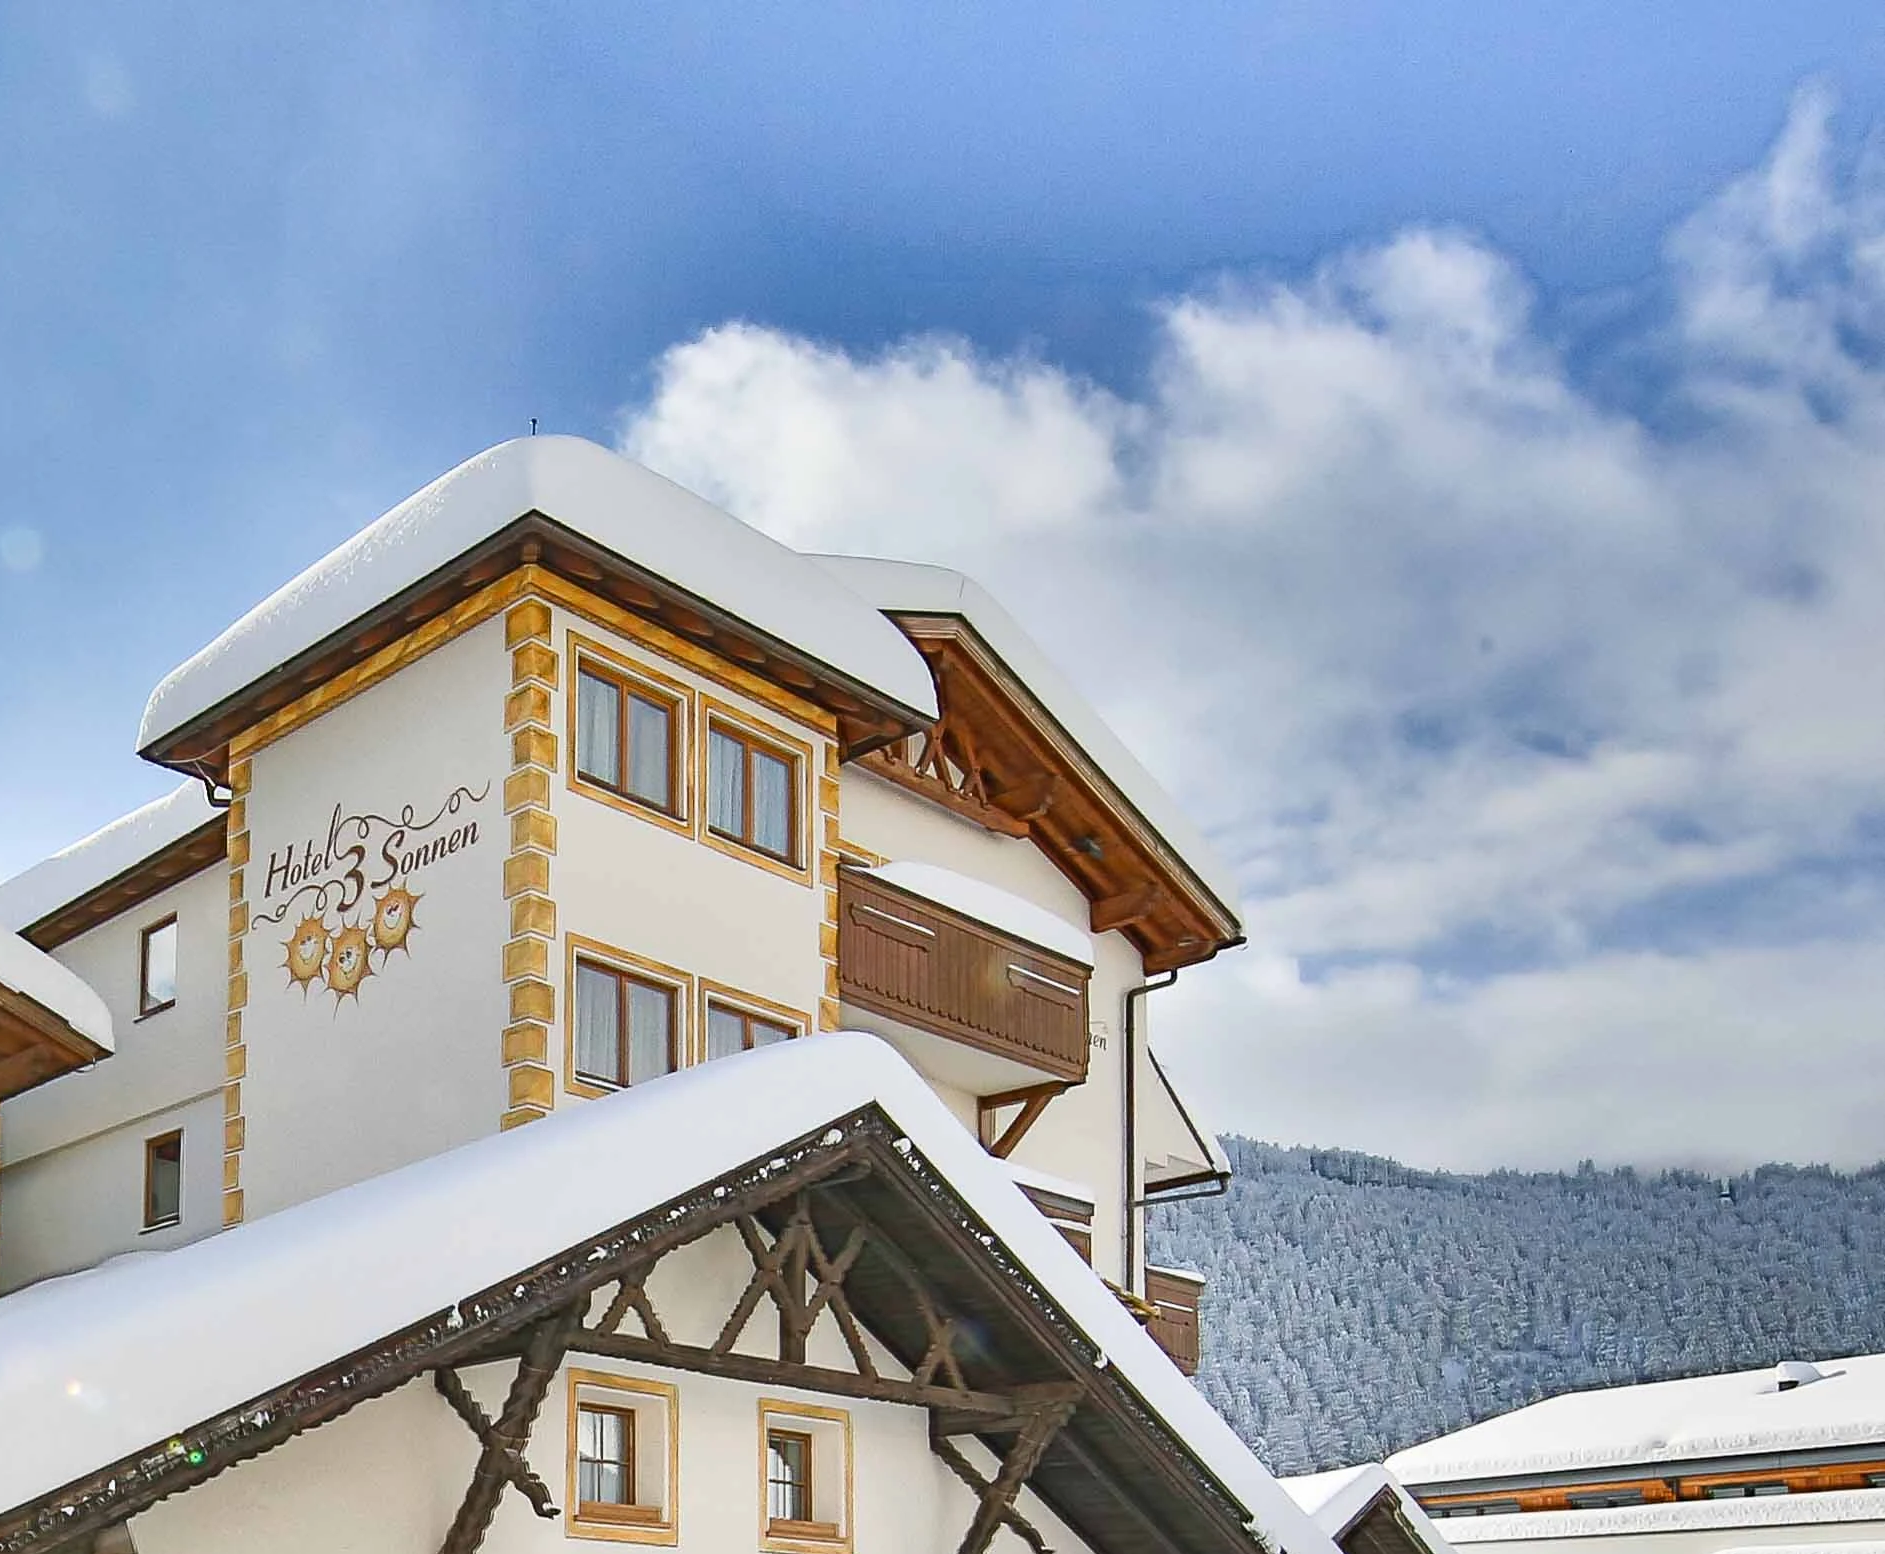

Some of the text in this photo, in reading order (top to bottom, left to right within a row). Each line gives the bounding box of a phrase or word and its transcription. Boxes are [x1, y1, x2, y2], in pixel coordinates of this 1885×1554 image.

[264, 802, 480, 913] Hotel 3 Sonnen
